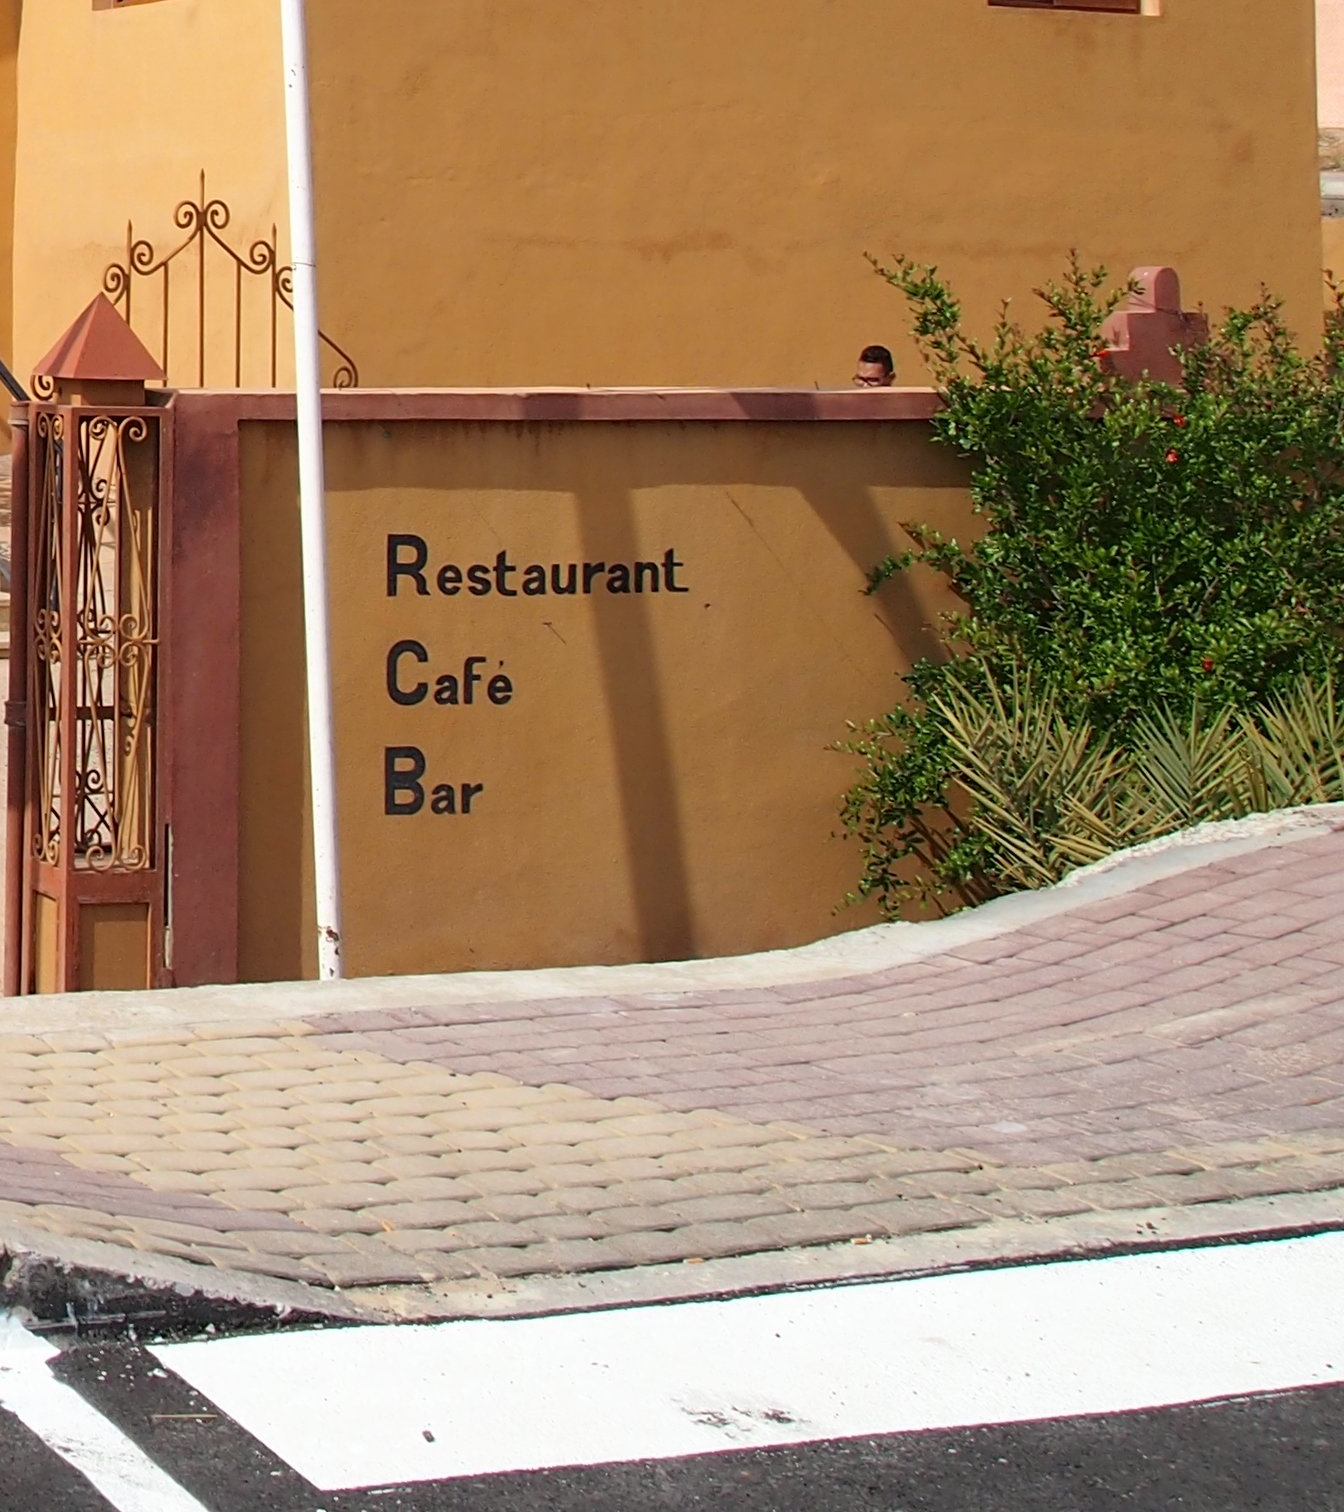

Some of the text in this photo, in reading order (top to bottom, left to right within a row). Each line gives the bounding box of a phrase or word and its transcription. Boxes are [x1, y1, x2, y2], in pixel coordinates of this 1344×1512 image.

[386, 534, 689, 597] Restaurant
[386, 639, 513, 706] Café
[384, 746, 484, 815] Bar
